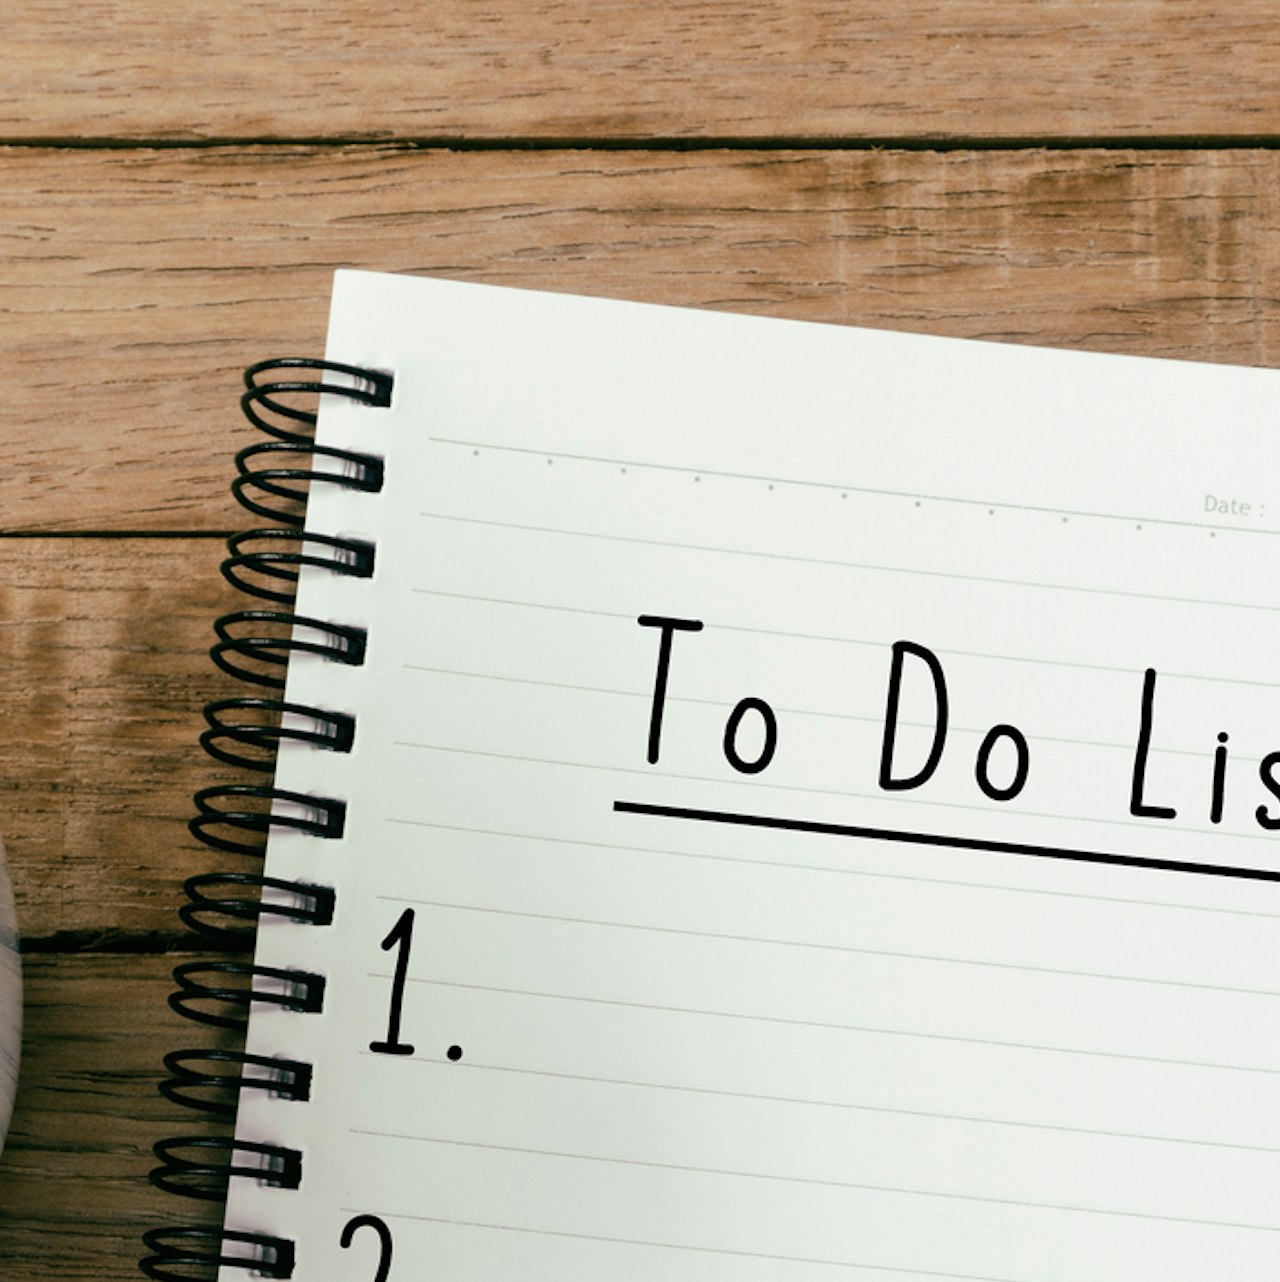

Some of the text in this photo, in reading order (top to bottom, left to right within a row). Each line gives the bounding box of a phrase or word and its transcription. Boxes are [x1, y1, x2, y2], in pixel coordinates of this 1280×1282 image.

[1204, 494, 1251, 516] Date
[637, 614, 778, 776] To
[878, 640, 1030, 802] Do
[369, 907, 464, 1063] 1.
